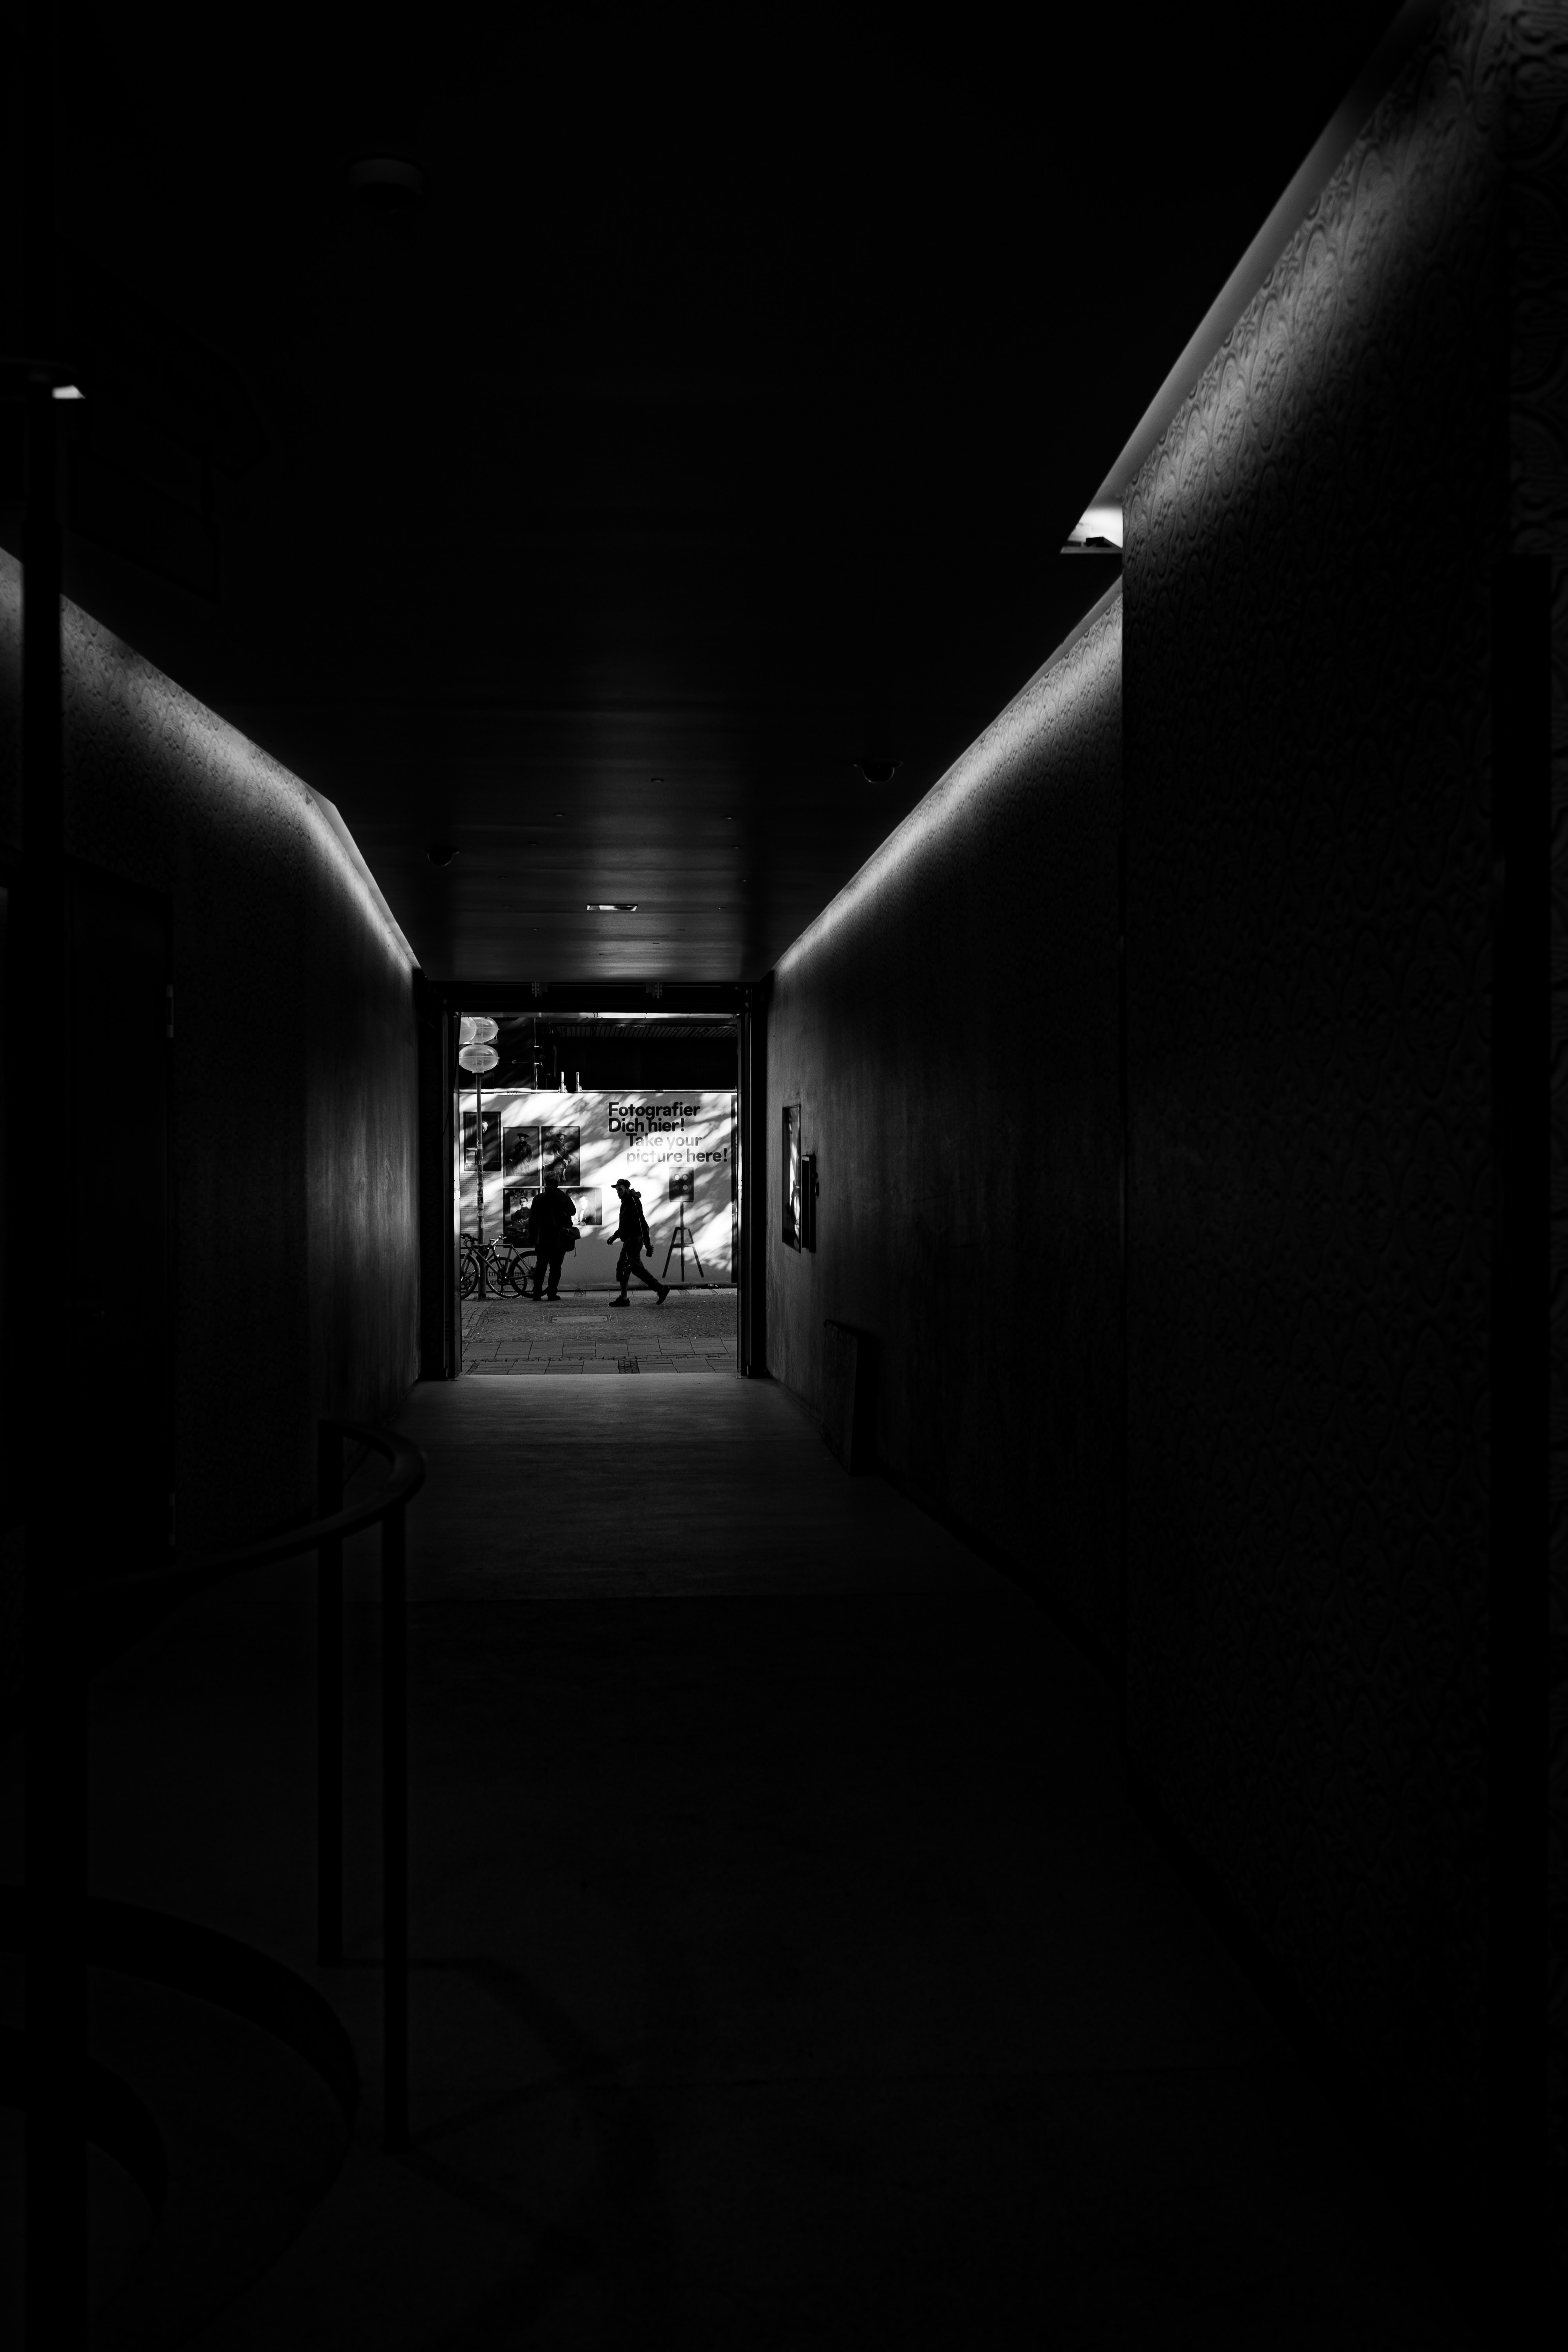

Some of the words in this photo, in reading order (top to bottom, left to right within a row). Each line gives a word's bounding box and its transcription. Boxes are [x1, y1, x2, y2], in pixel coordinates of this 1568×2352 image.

[608, 1102, 701, 1120] Fotografier
[608, 1118, 644, 1132] Dich
[648, 1117, 684, 1132] hier!
[626, 1132, 663, 1147] Take
[667, 1136, 702, 1150] your
[627, 1148, 682, 1165] picture
[687, 1148, 727, 1162] here!
